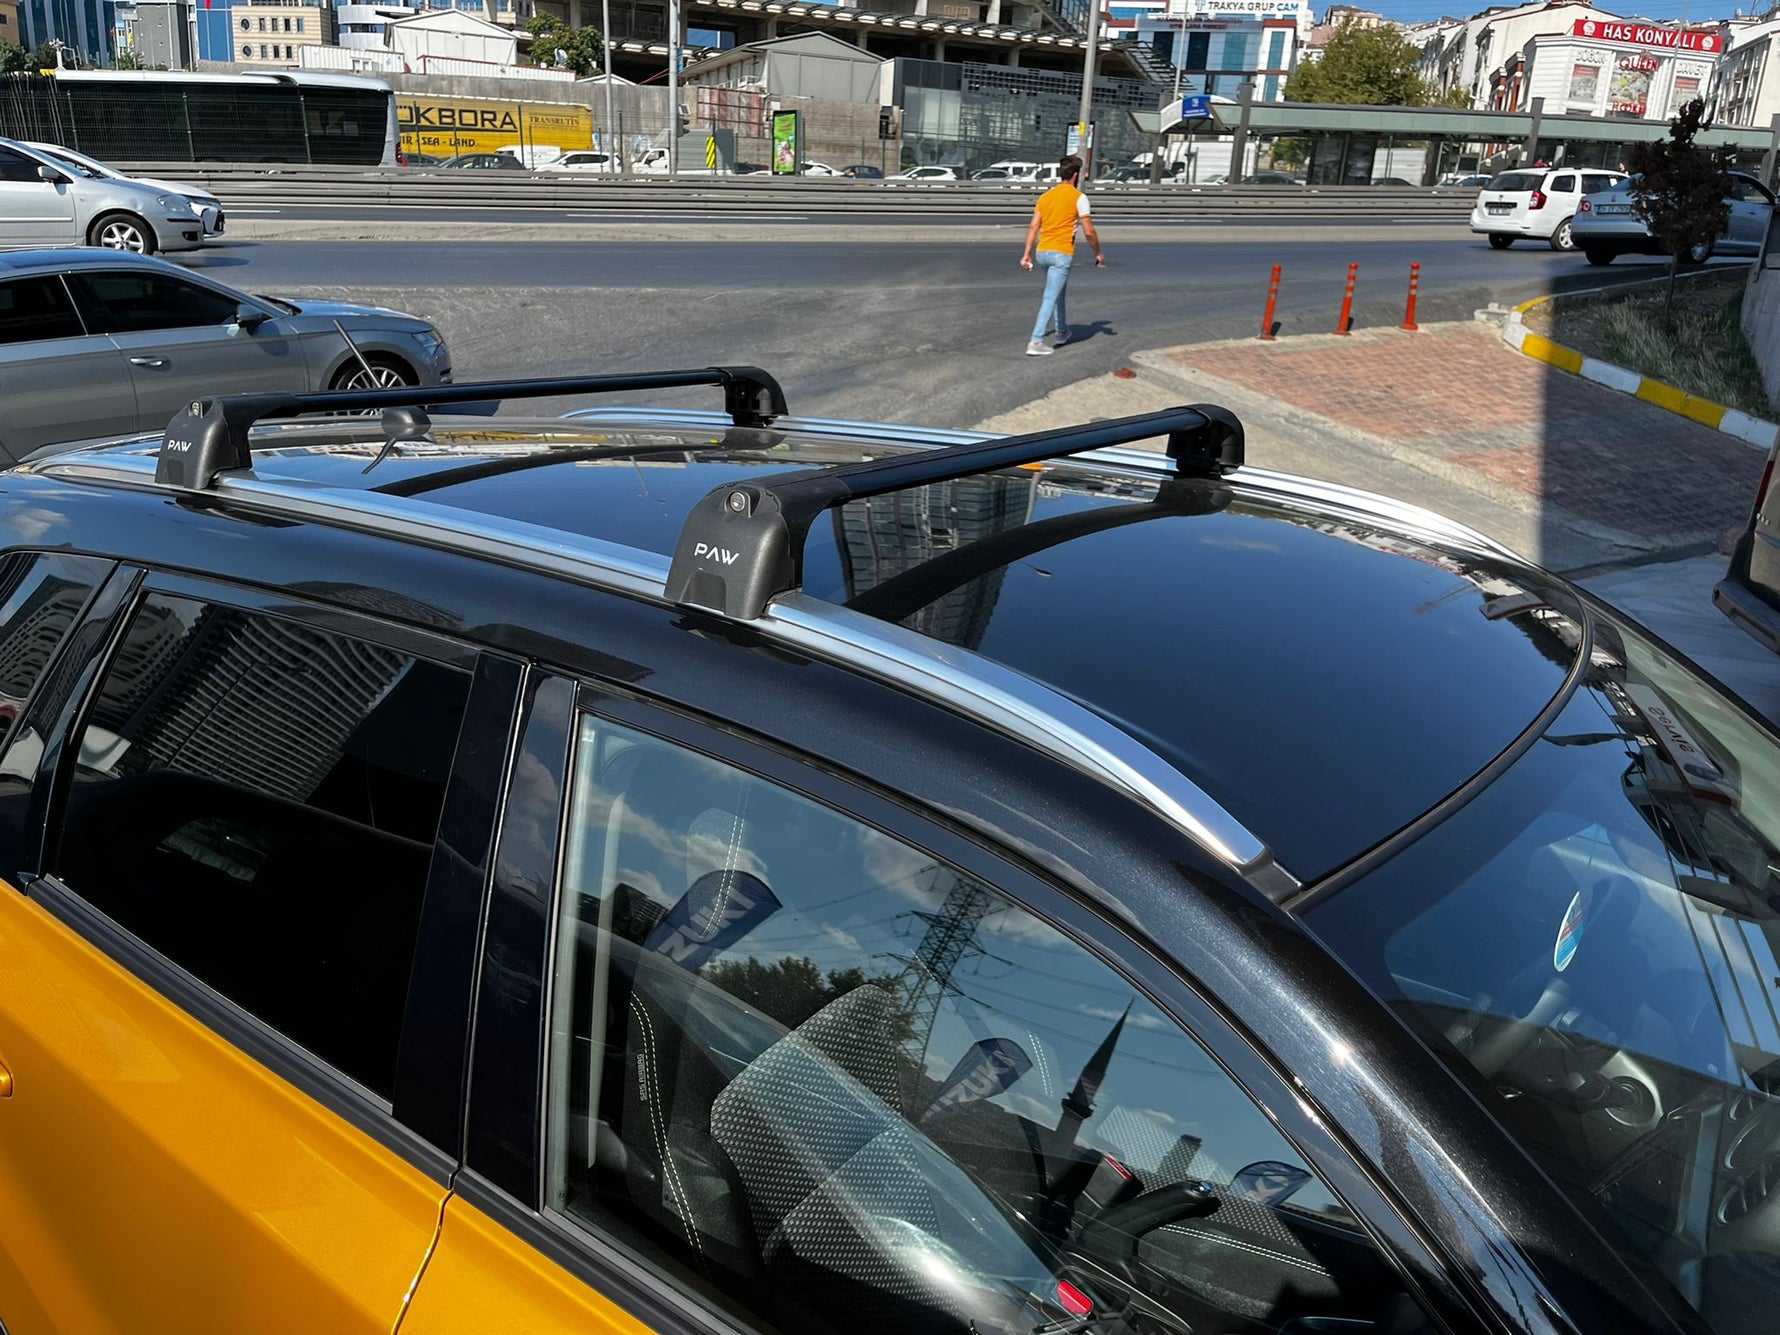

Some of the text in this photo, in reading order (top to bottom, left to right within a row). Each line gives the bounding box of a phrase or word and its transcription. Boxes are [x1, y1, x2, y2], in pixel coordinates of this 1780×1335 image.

[1208, 1, 1299, 12] TRAKYA GRUP CAM
[1603, 24, 1696, 48] HAS KONYALI
[402, 136, 476, 147] IR SEA LAND
[167, 440, 192, 452] PAW
[694, 542, 740, 565] PAW
